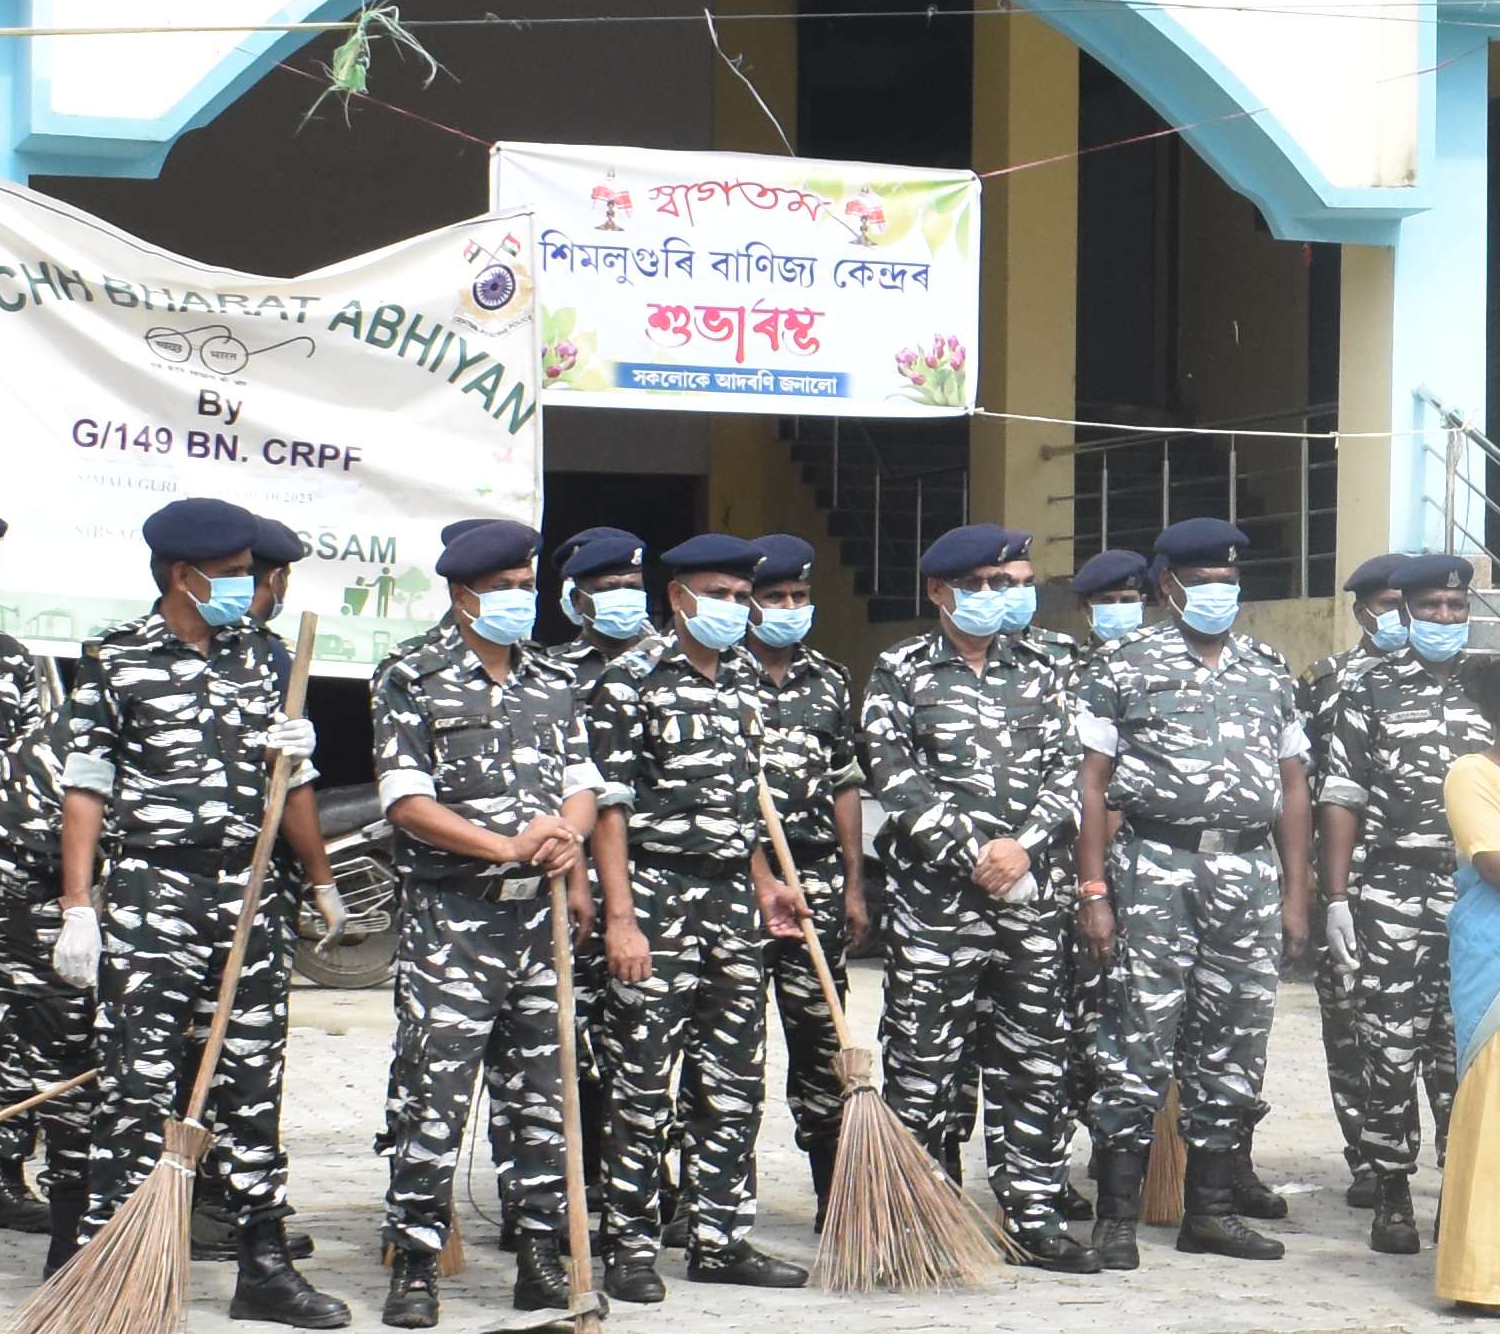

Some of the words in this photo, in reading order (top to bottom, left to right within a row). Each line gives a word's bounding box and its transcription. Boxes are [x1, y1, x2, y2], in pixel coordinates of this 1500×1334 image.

[648, 178, 832, 227] স্বাগতম
[538, 229, 695, 286] শিমলুগুৰি
[710, 241, 817, 289] বাণিজ্য
[101, 274, 321, 324] BHARAT
[328, 299, 537, 435] ABHIYAN
[210, 350, 238, 361] भारत
[633, 367, 711, 389] সকলোকে
[197, 389, 243, 425] By
[71, 418, 173, 454] G/149
[187, 430, 249, 463] BN.
[262, 439, 364, 472] CRPF
[297, 529, 397, 565] SSAM
